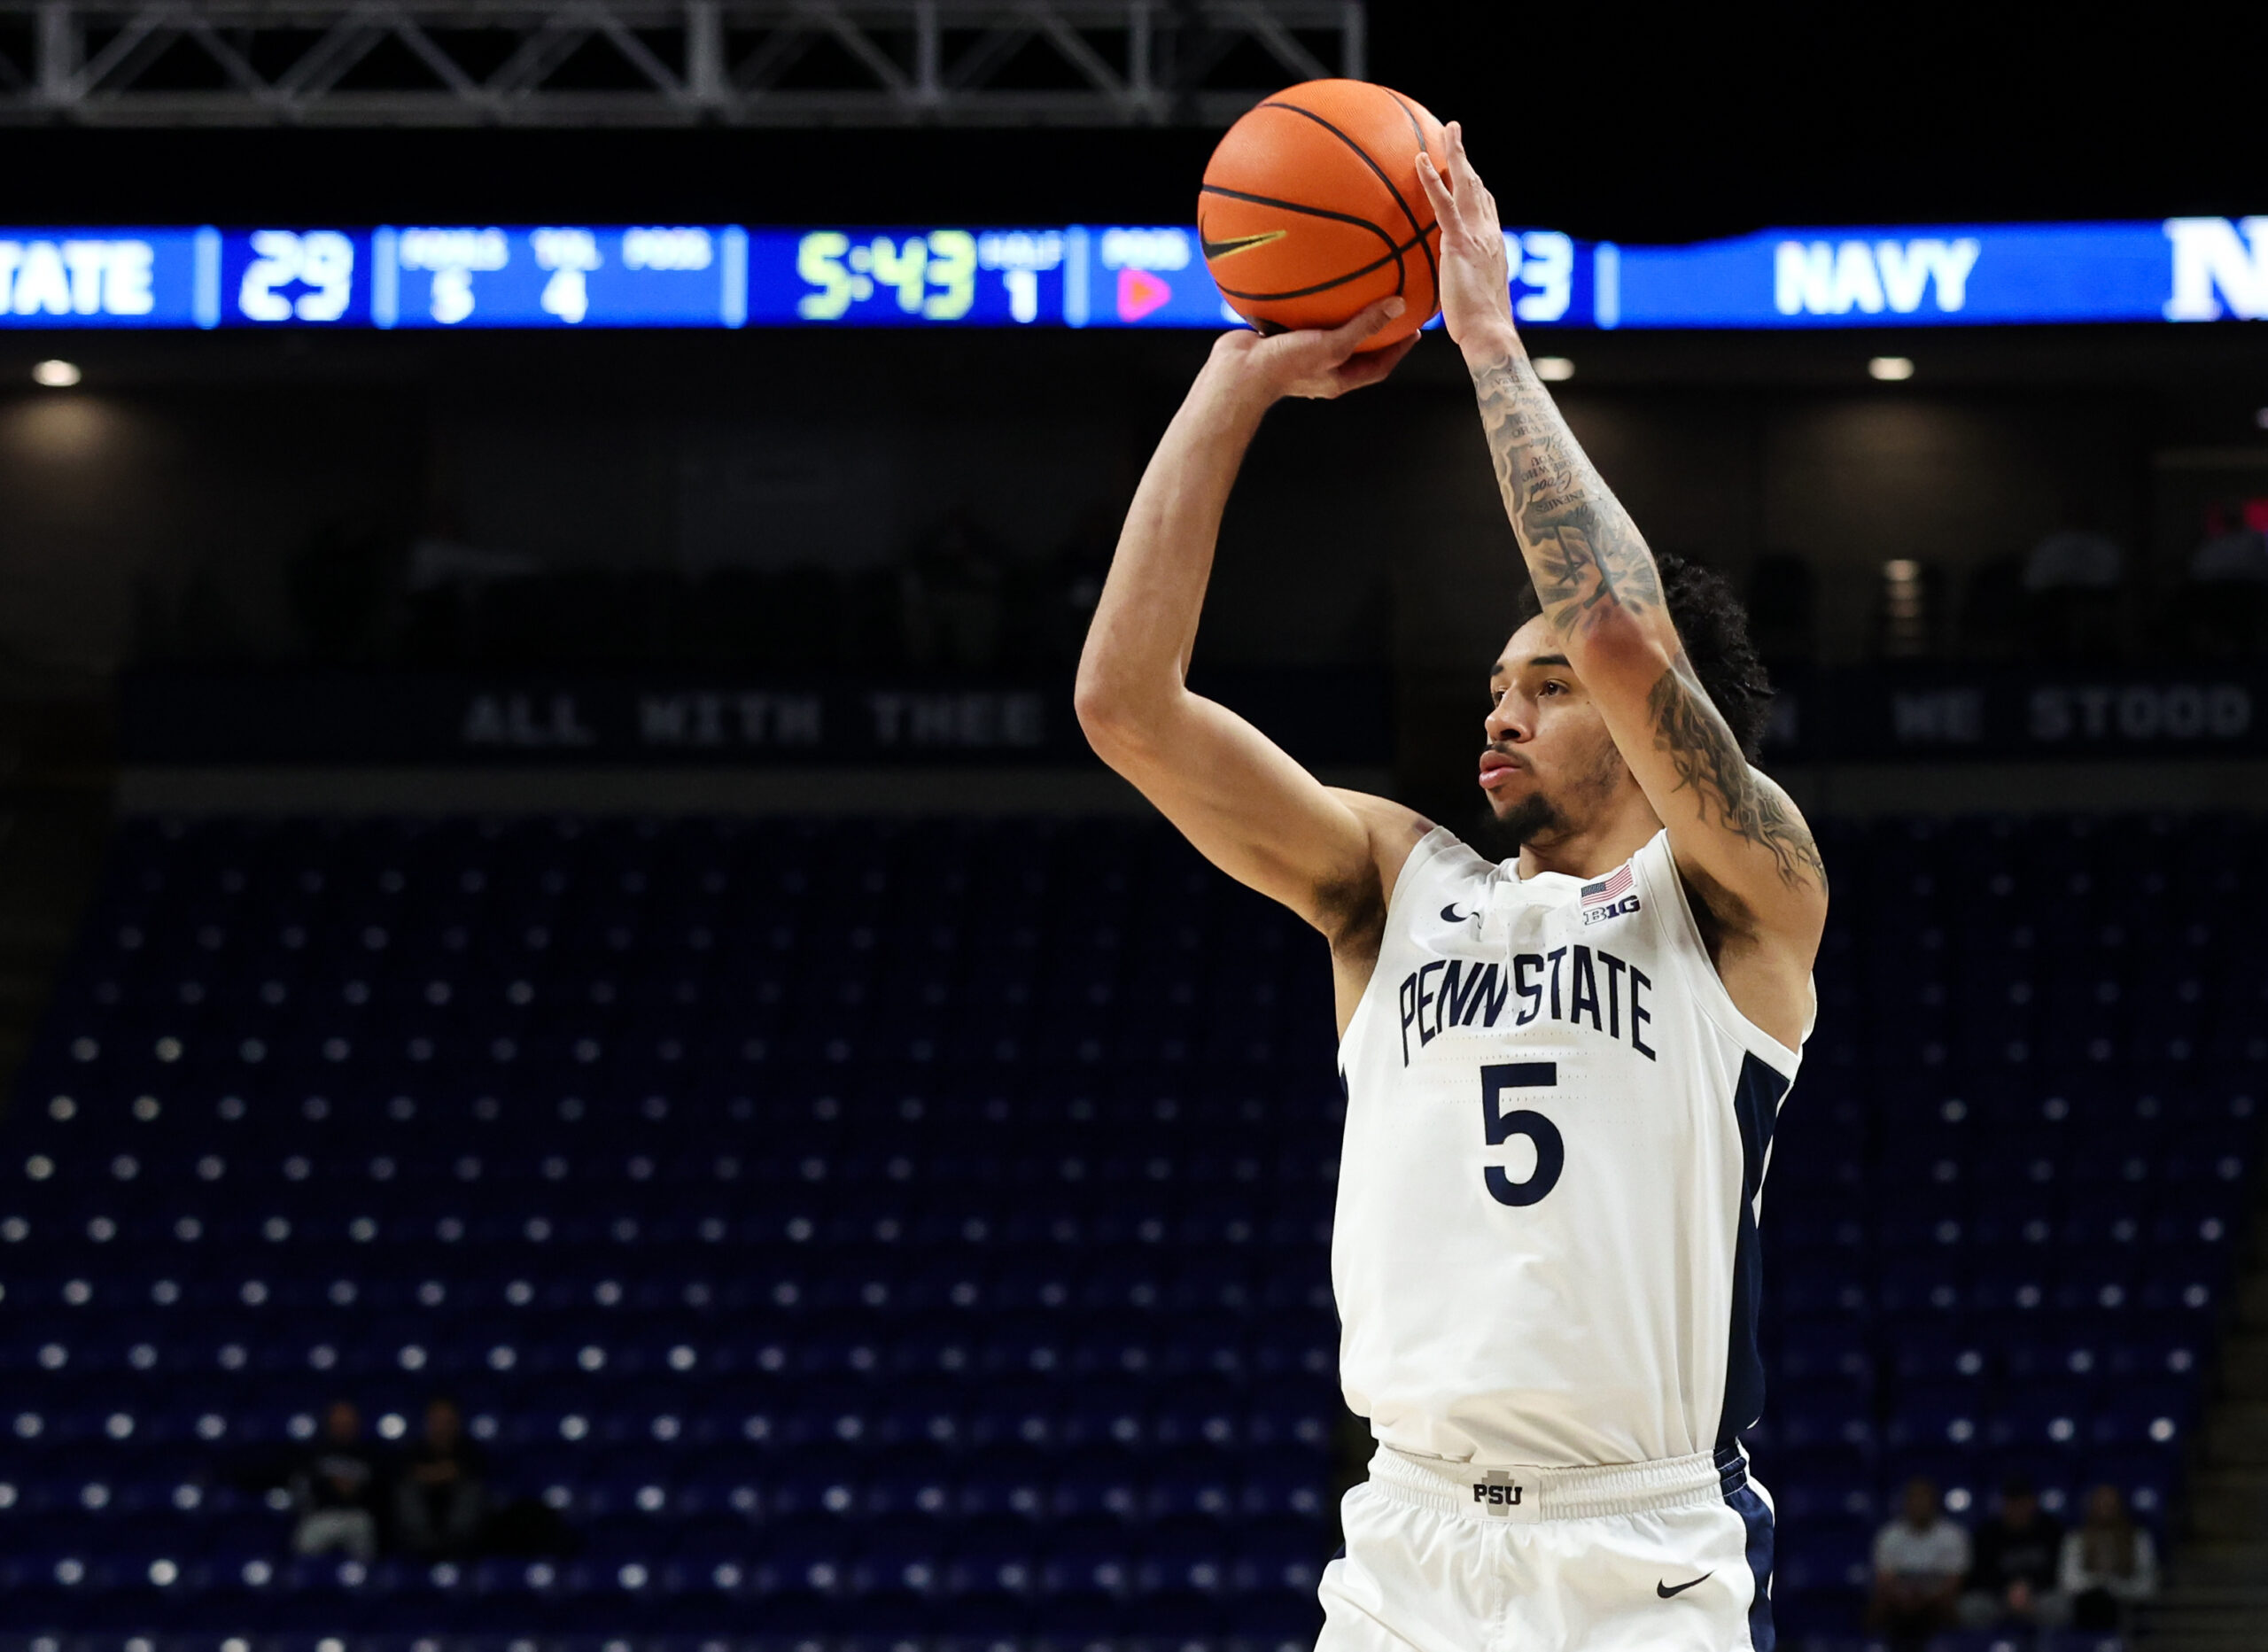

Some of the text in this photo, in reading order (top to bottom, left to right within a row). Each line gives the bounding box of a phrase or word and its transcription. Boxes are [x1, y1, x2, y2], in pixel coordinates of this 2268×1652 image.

[238, 229, 354, 322] 29
[797, 230, 976, 321] 5:43
[1003, 269, 1038, 324] 1
[1775, 238, 1981, 316] NAVY
[460, 691, 1046, 748] ALL WITH THEE
[2028, 684, 2253, 741] STOOD
[1399, 944, 1657, 1068] PENN STATE
[1480, 1061, 1565, 1207] 5
[1473, 1484, 1523, 1505] PSU
